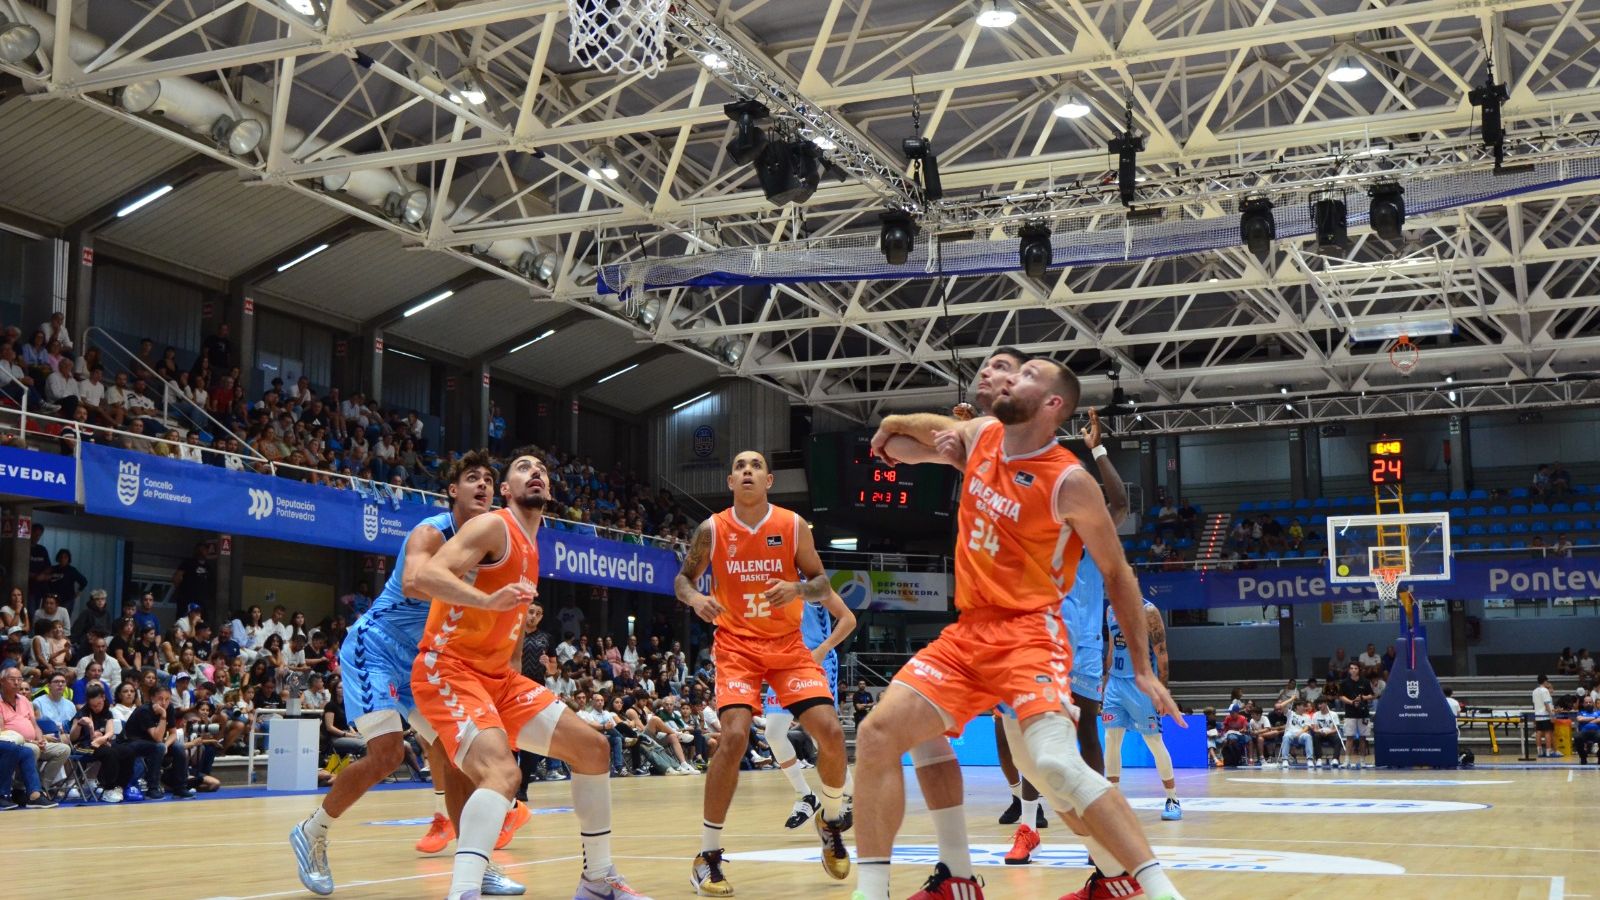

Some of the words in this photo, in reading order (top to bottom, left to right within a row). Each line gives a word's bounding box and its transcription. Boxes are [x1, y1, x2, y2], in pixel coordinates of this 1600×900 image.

[0, 463, 67, 485] EVEDRA
[873, 469, 897, 482] 6:48
[1372, 459, 1401, 482] 24
[143, 477, 174, 491] Concello
[143, 489, 153, 498] de
[153, 491, 192, 504] Pontevedra
[276, 496, 316, 512] Deputación
[899, 491, 908, 504] 3
[276, 507, 316, 522] Pontevedra
[968, 517, 1000, 558] 24
[554, 541, 654, 584] Pontevedra
[726, 559, 784, 575] VALENCIA
[740, 573, 770, 582] BASKET
[742, 593, 772, 618] 32
[1114, 656, 1125, 671] 10
